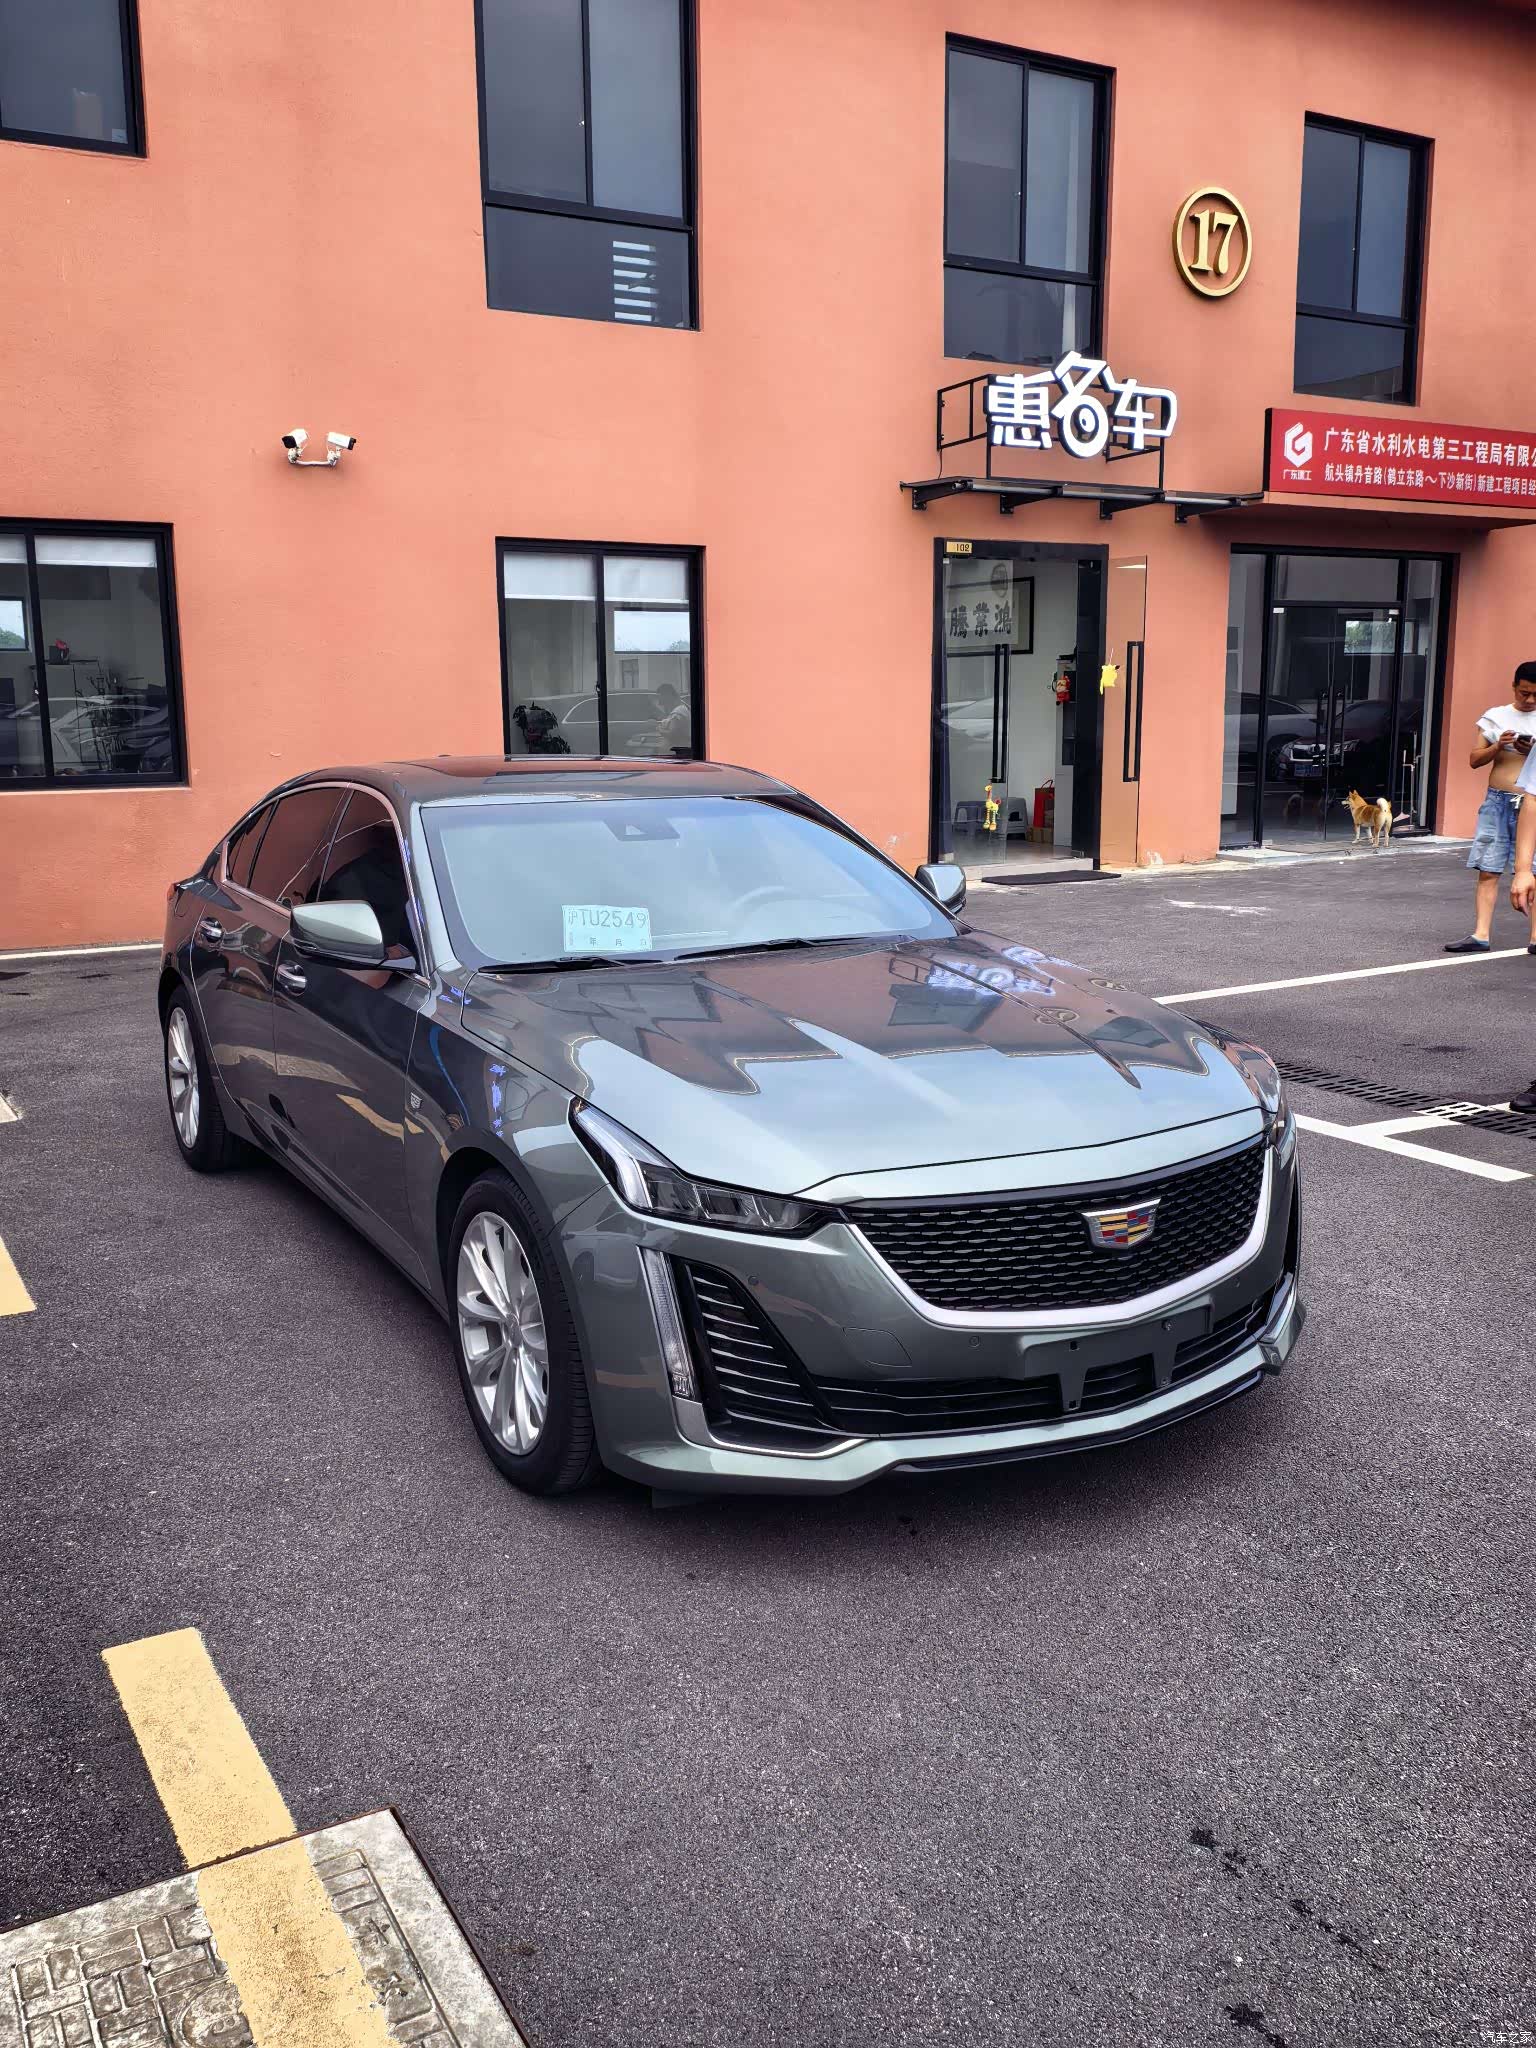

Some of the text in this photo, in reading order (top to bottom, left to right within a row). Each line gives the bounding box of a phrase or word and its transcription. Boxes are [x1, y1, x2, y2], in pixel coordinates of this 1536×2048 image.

[1188, 209, 1239, 276] 17
[984, 350, 1178, 458] 惠名车
[956, 543, 970, 552] 102
